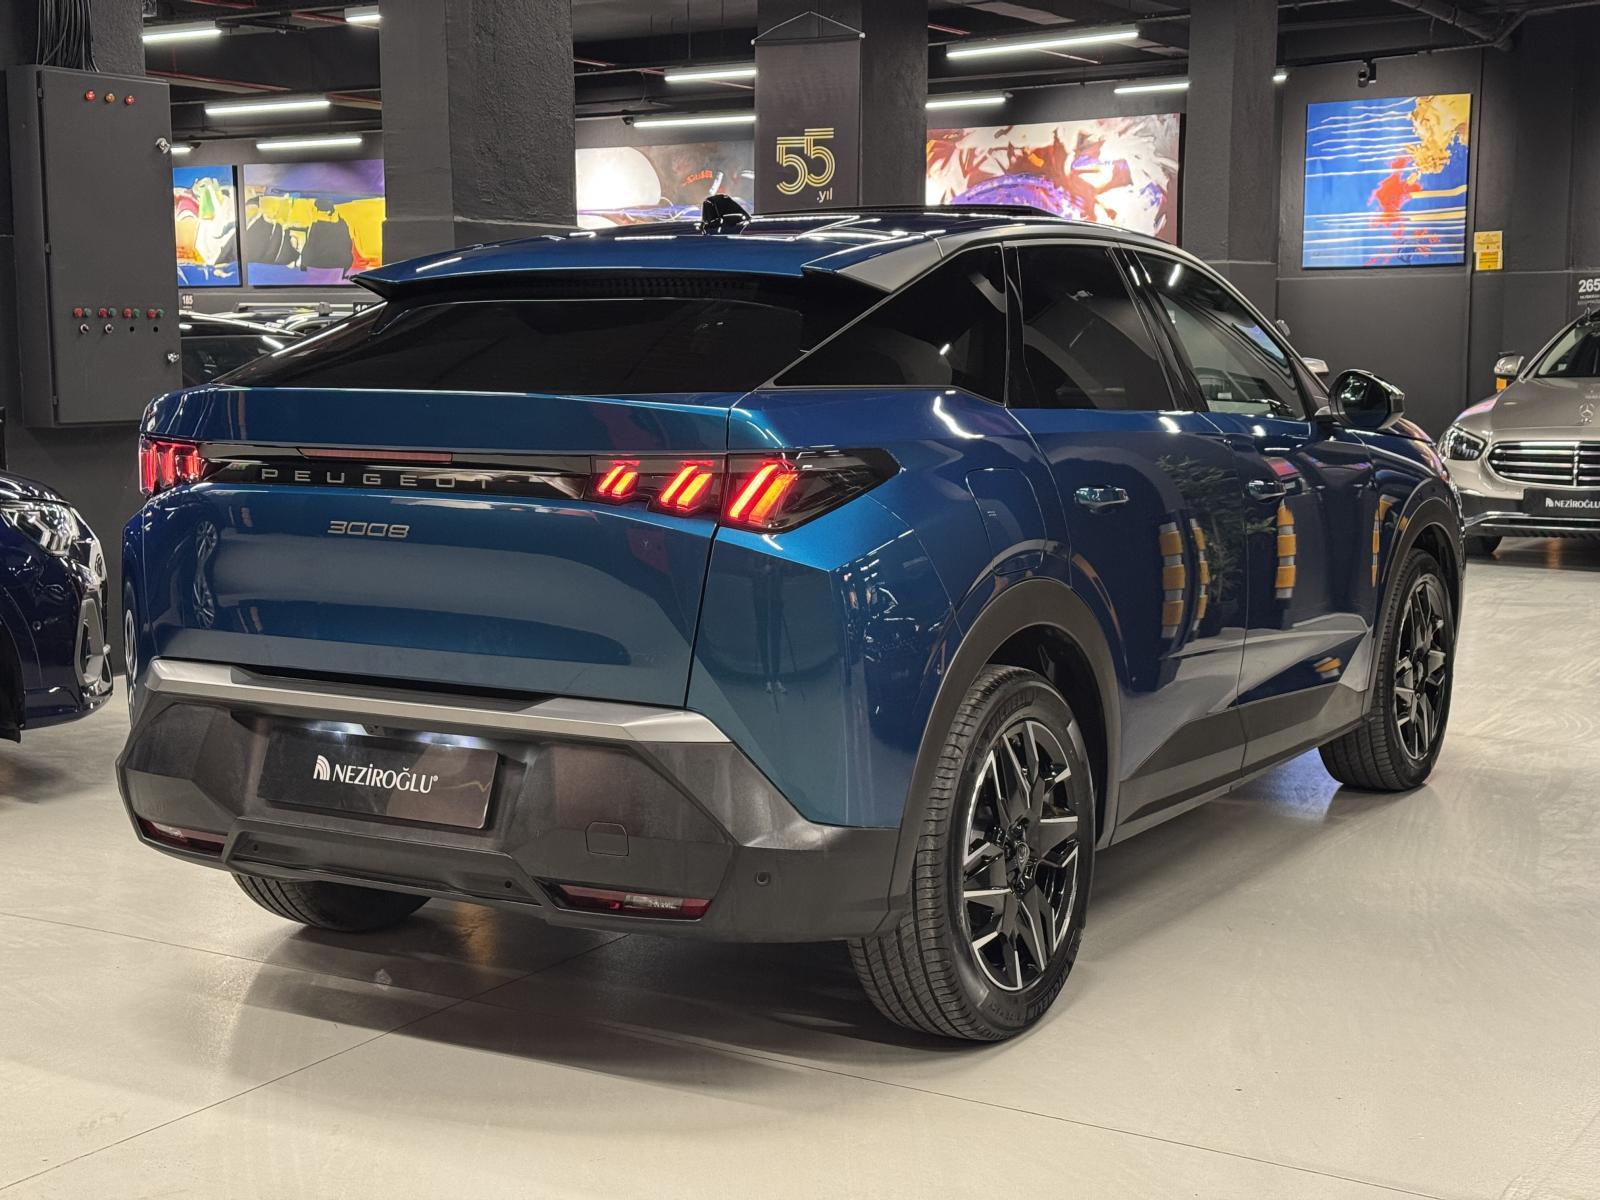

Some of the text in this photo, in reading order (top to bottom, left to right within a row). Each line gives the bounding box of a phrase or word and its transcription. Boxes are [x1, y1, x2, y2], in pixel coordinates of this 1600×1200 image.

[776, 127, 836, 195] 55
[1578, 278, 1600, 293] 265
[261, 468, 493, 490] PEUGEOT
[327, 519, 410, 539] 3008
[332, 763, 434, 794] NEZİROĞLU
